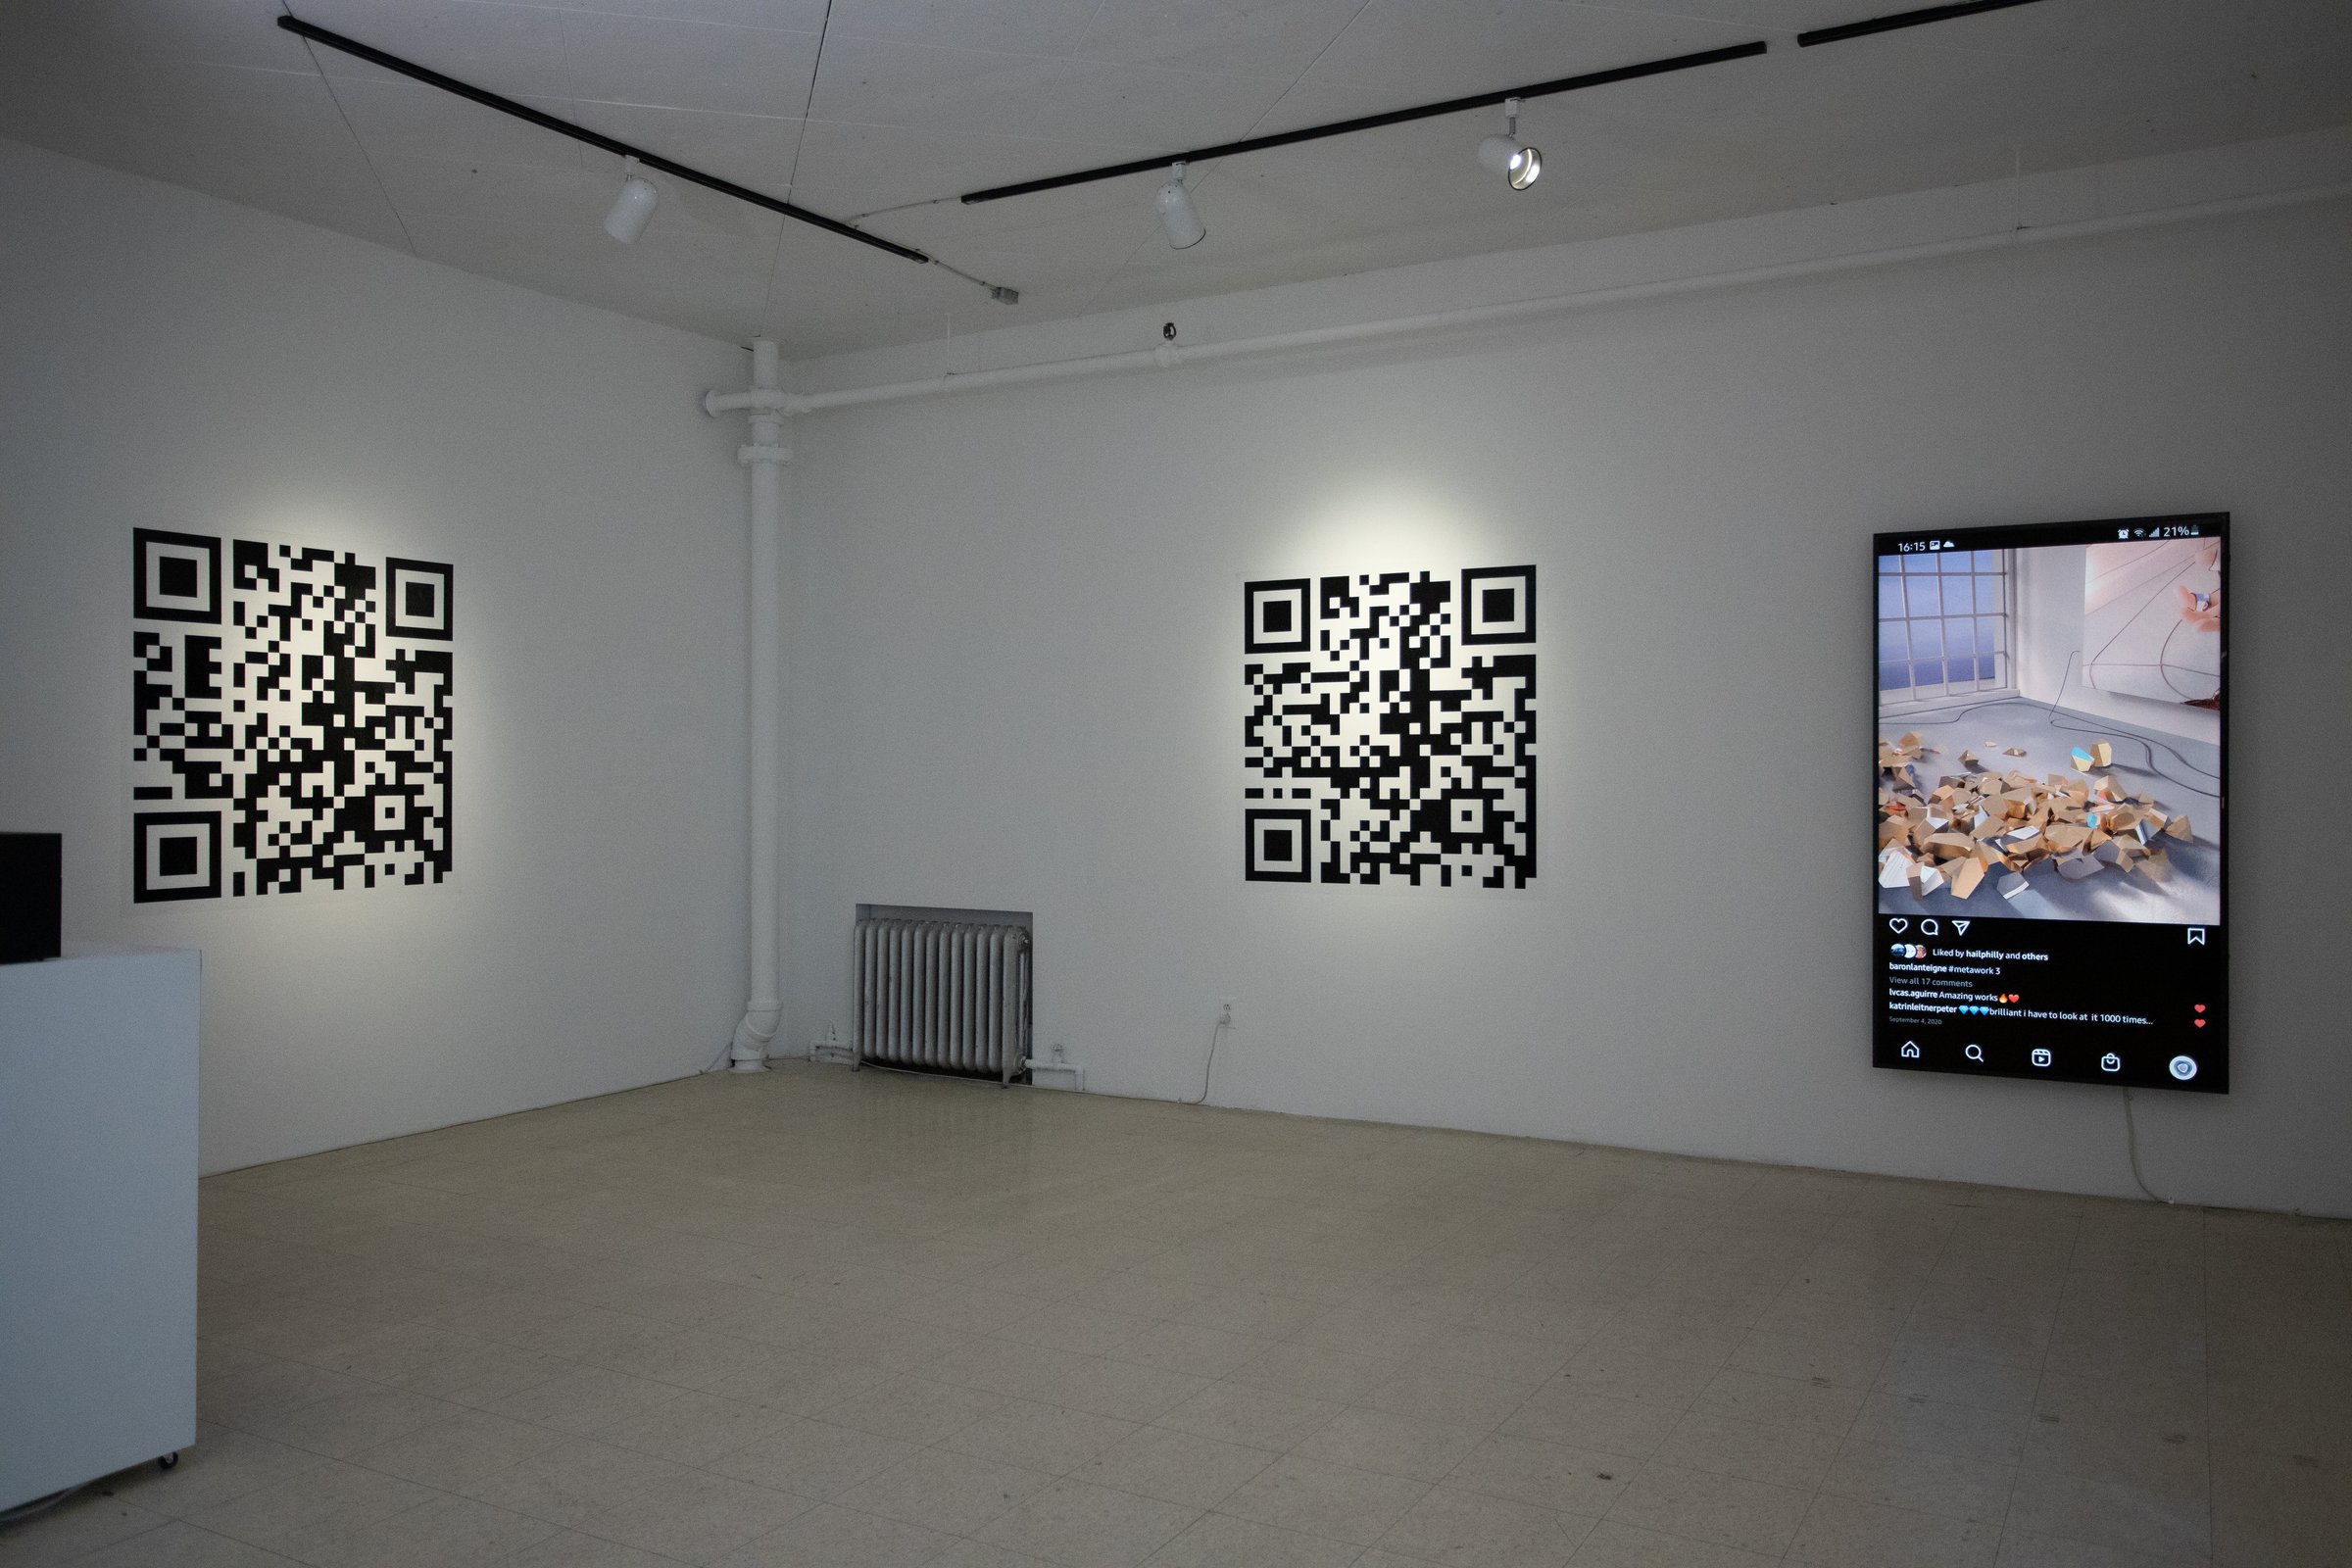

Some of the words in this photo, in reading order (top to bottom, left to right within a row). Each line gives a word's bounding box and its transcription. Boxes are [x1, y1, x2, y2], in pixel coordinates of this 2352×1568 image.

[2163, 526, 2189, 537] 21%
[1898, 541, 1926, 553] 16:15
[1933, 949, 1953, 957] Liked
[1955, 949, 1965, 958] by
[1966, 950, 2004, 959] hailphilly
[2022, 953, 2048, 961] others
[1889, 962, 1947, 973] baronlanteigne
[1948, 965, 1993, 975] #metawork
[1939, 992, 1974, 1002] Amazing
[1889, 1002, 1957, 1013] katrinleitnerpeter
[1989, 1008, 2022, 1017] brilliant
[2028, 1009, 2047, 1018] have
[2059, 1011, 2078, 1020] look
[2079, 1012, 2087, 1021] at
[2100, 1014, 2121, 1023] 1000
